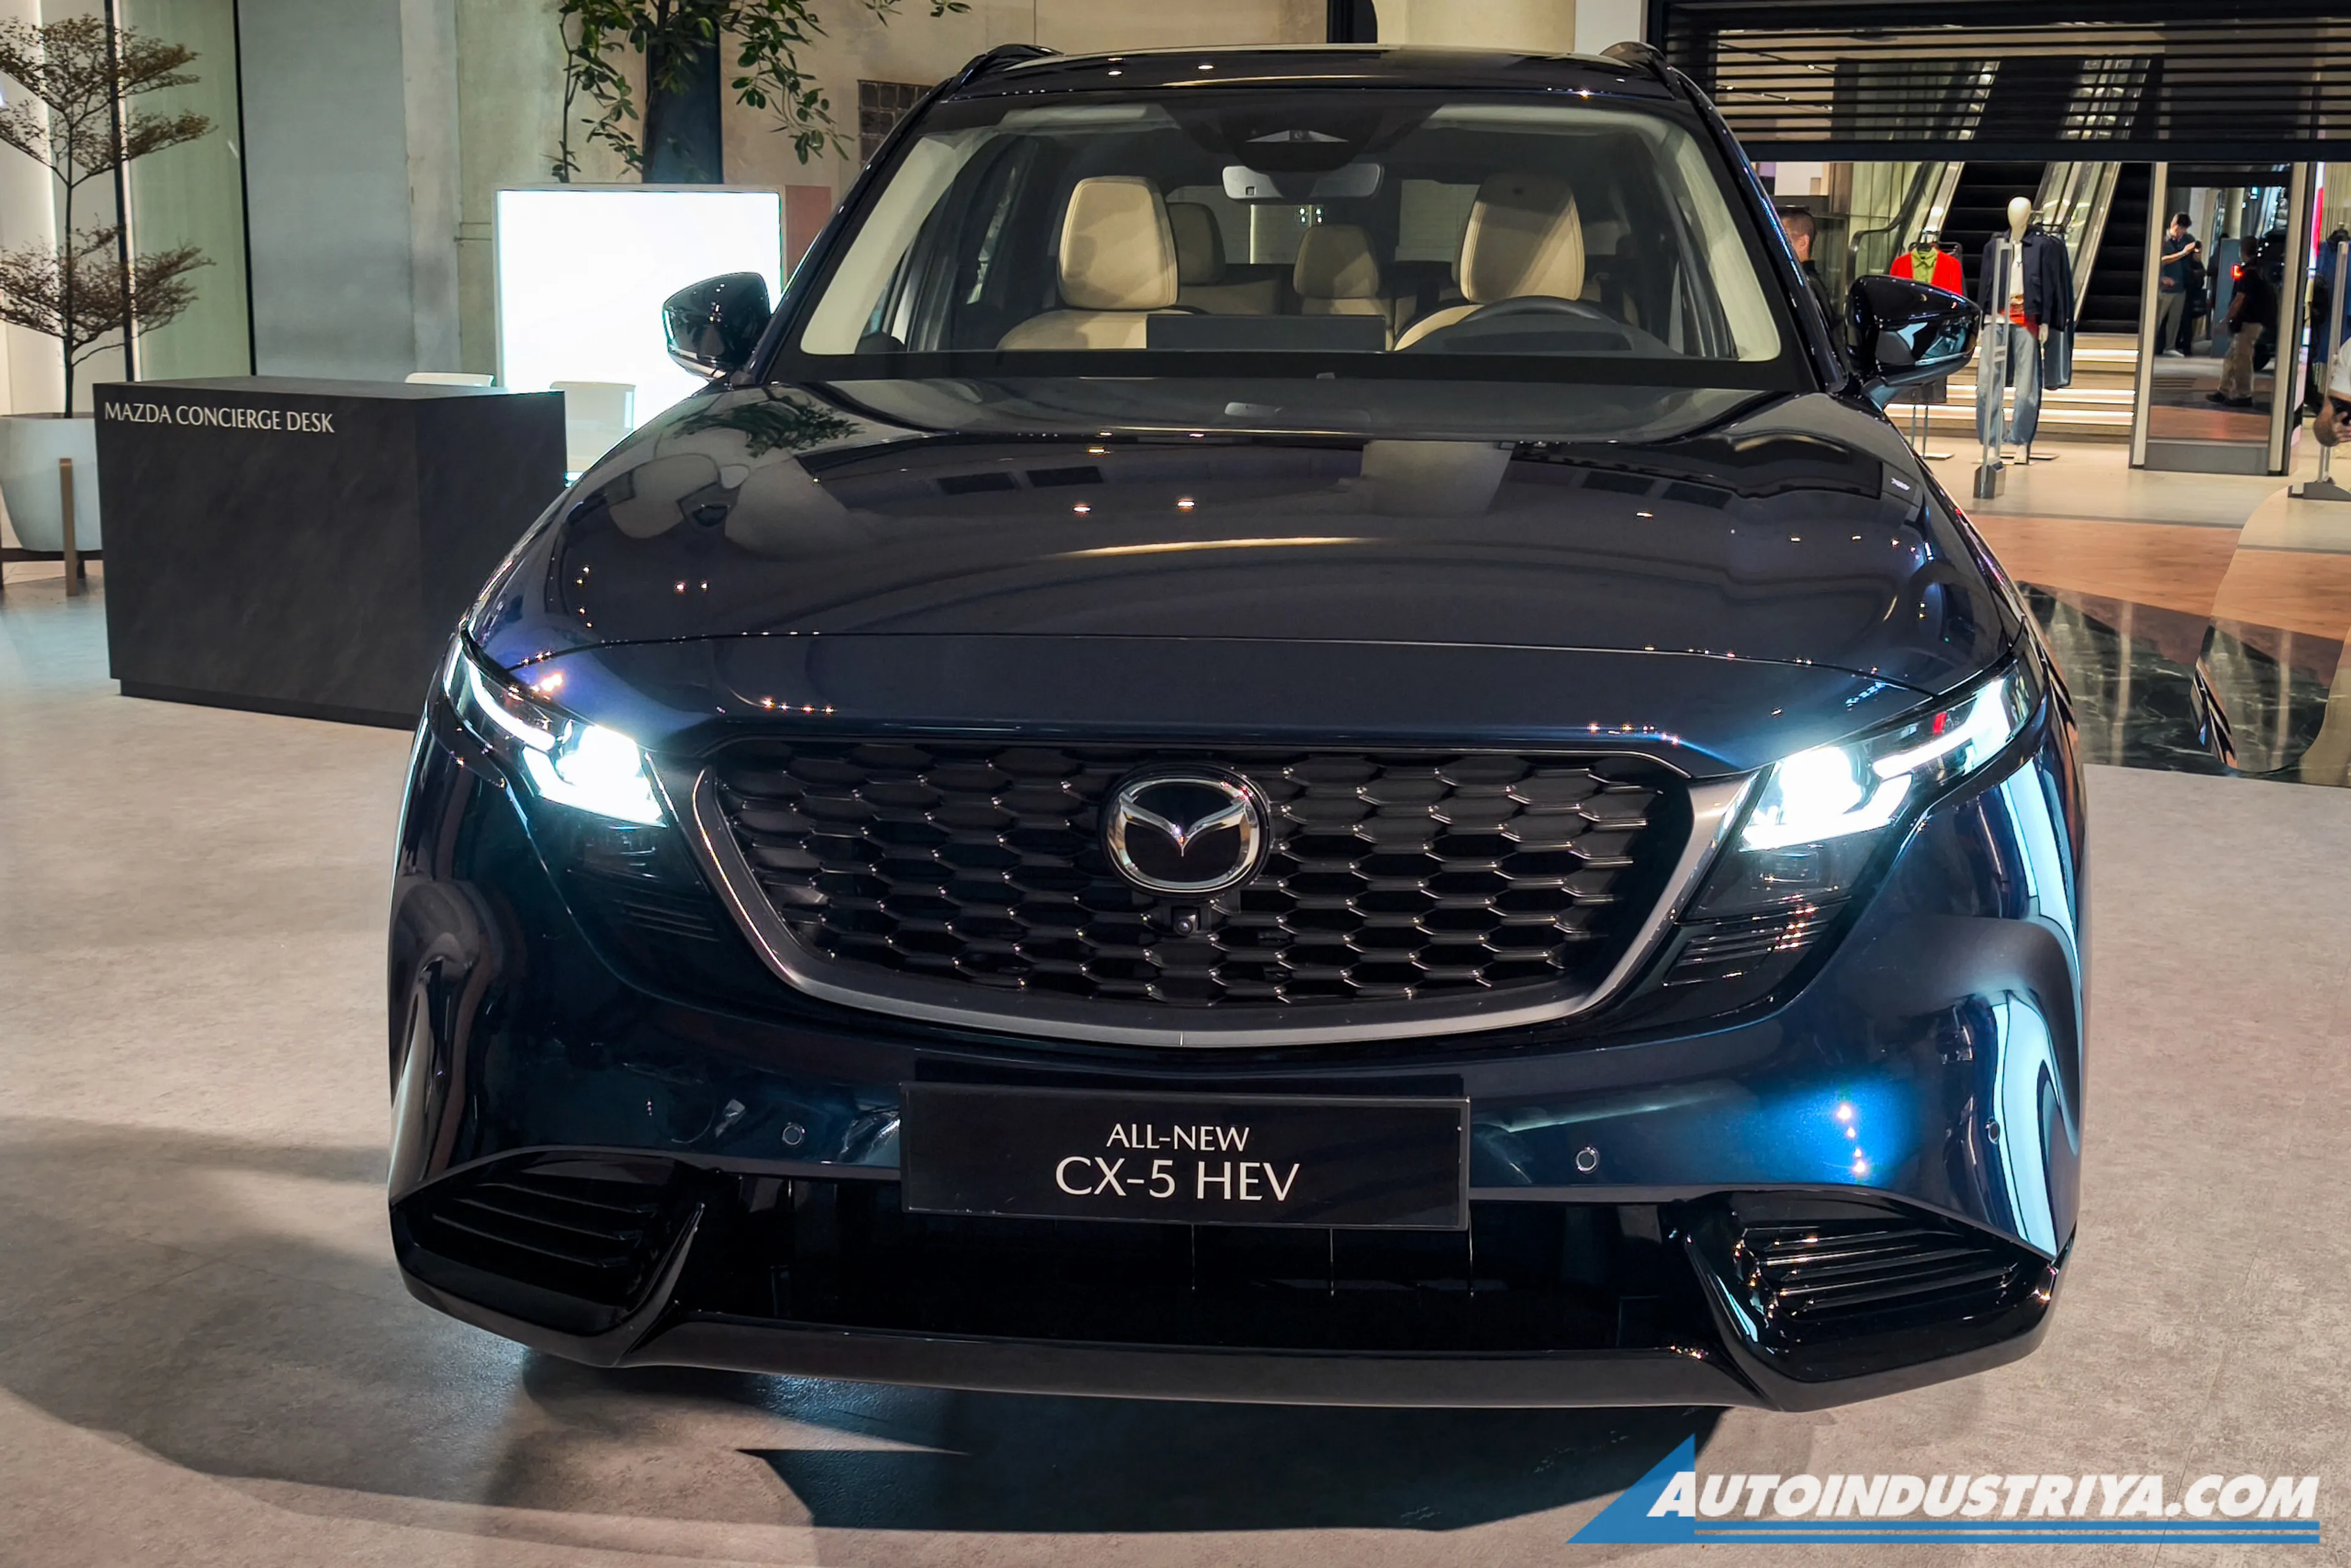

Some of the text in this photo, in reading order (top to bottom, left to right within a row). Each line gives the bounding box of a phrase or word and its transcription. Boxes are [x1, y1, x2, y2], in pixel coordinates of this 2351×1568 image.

[105, 402, 335, 433] MAZDA CONCIERGE DESK
[1106, 1123, 1250, 1152] ALL-NEW
[1056, 1156, 1300, 1201] CX-5 HEV
